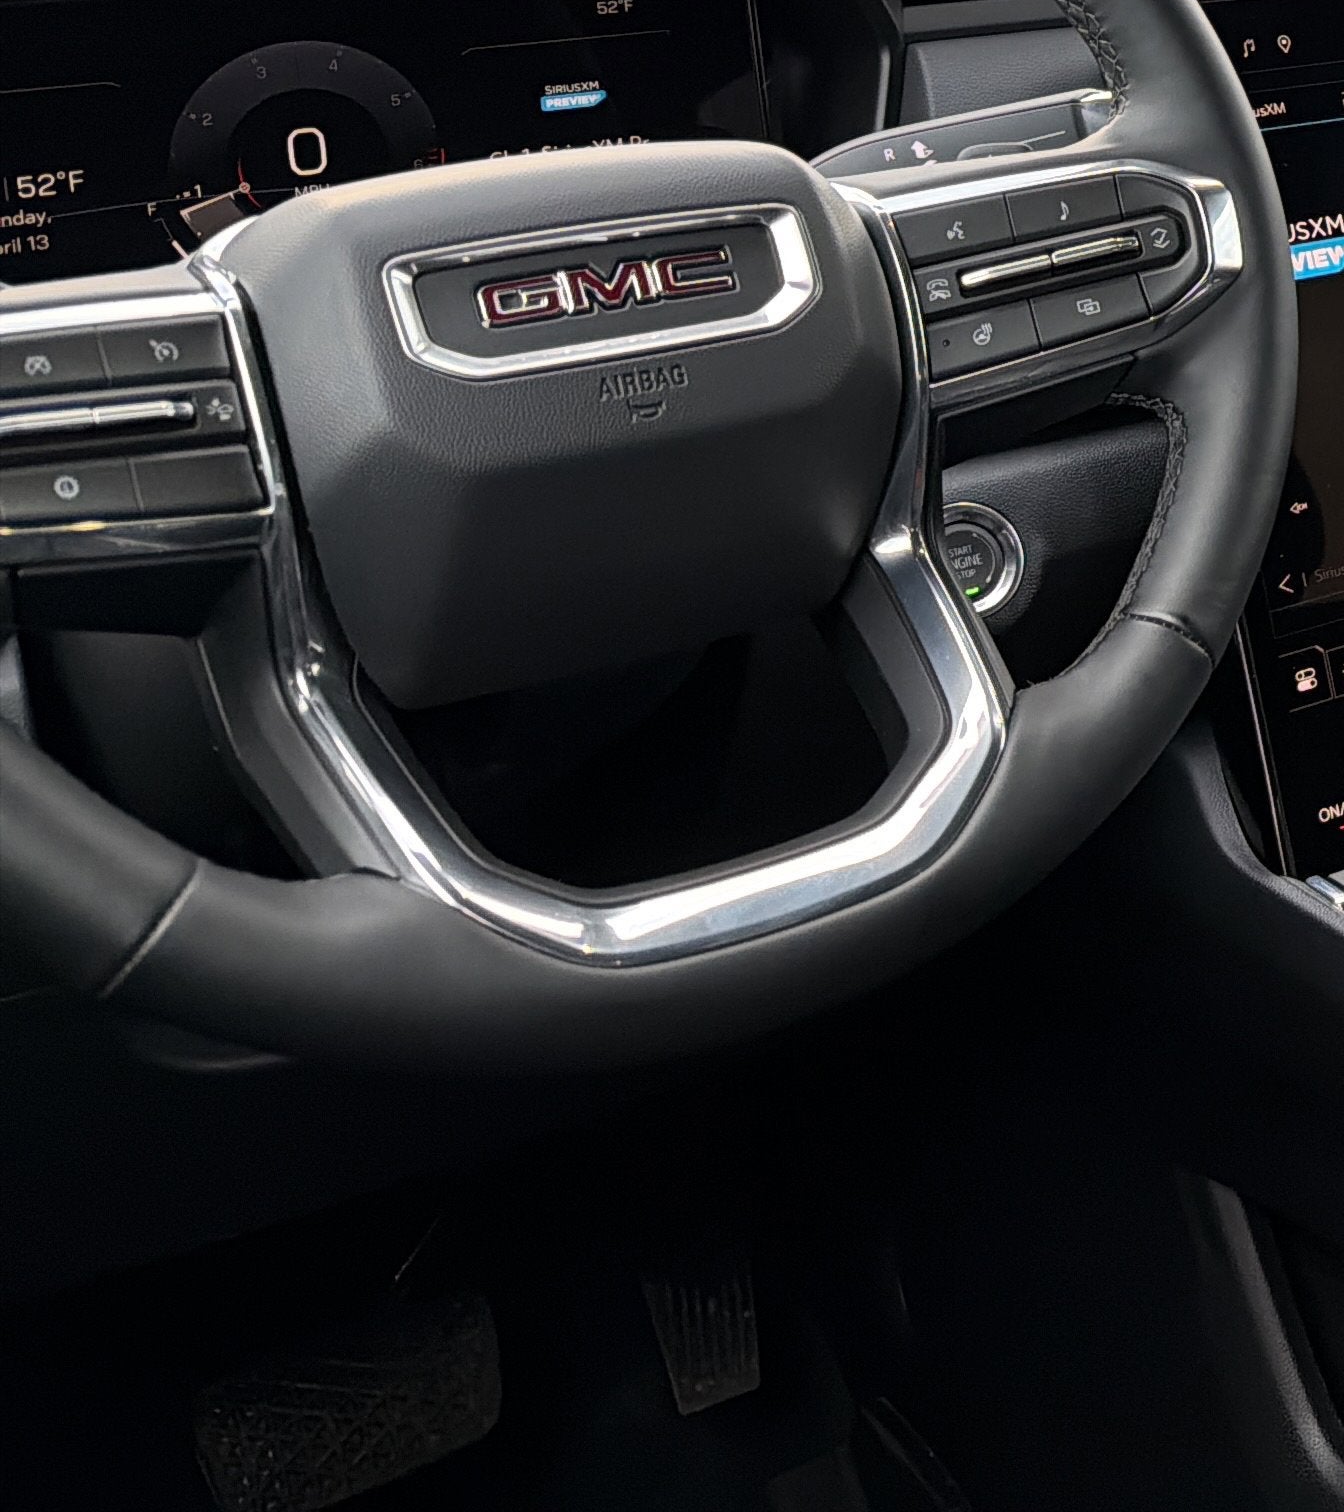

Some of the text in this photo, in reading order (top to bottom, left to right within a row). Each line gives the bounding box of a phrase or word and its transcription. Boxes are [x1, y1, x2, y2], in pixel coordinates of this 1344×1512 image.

[596, 0, 633, 14] 52°F
[256, 66, 267, 80] 3
[328, 59, 339, 73] 4
[544, 80, 600, 95] SIRIUSXM
[390, 93, 401, 107] 5
[545, 93, 599, 108] PREVIEW
[202, 112, 214, 127] 2
[287, 126, 328, 177] 0
[883, 148, 896, 163] R
[16, 169, 84, 200] 52°F
[193, 184, 203, 199] 1
[147, 201, 158, 217] F
[26, 234, 50, 252] 13
[475, 246, 739, 329] GMC
[599, 363, 689, 402] AIRBAG
[948, 544, 972, 558] START
